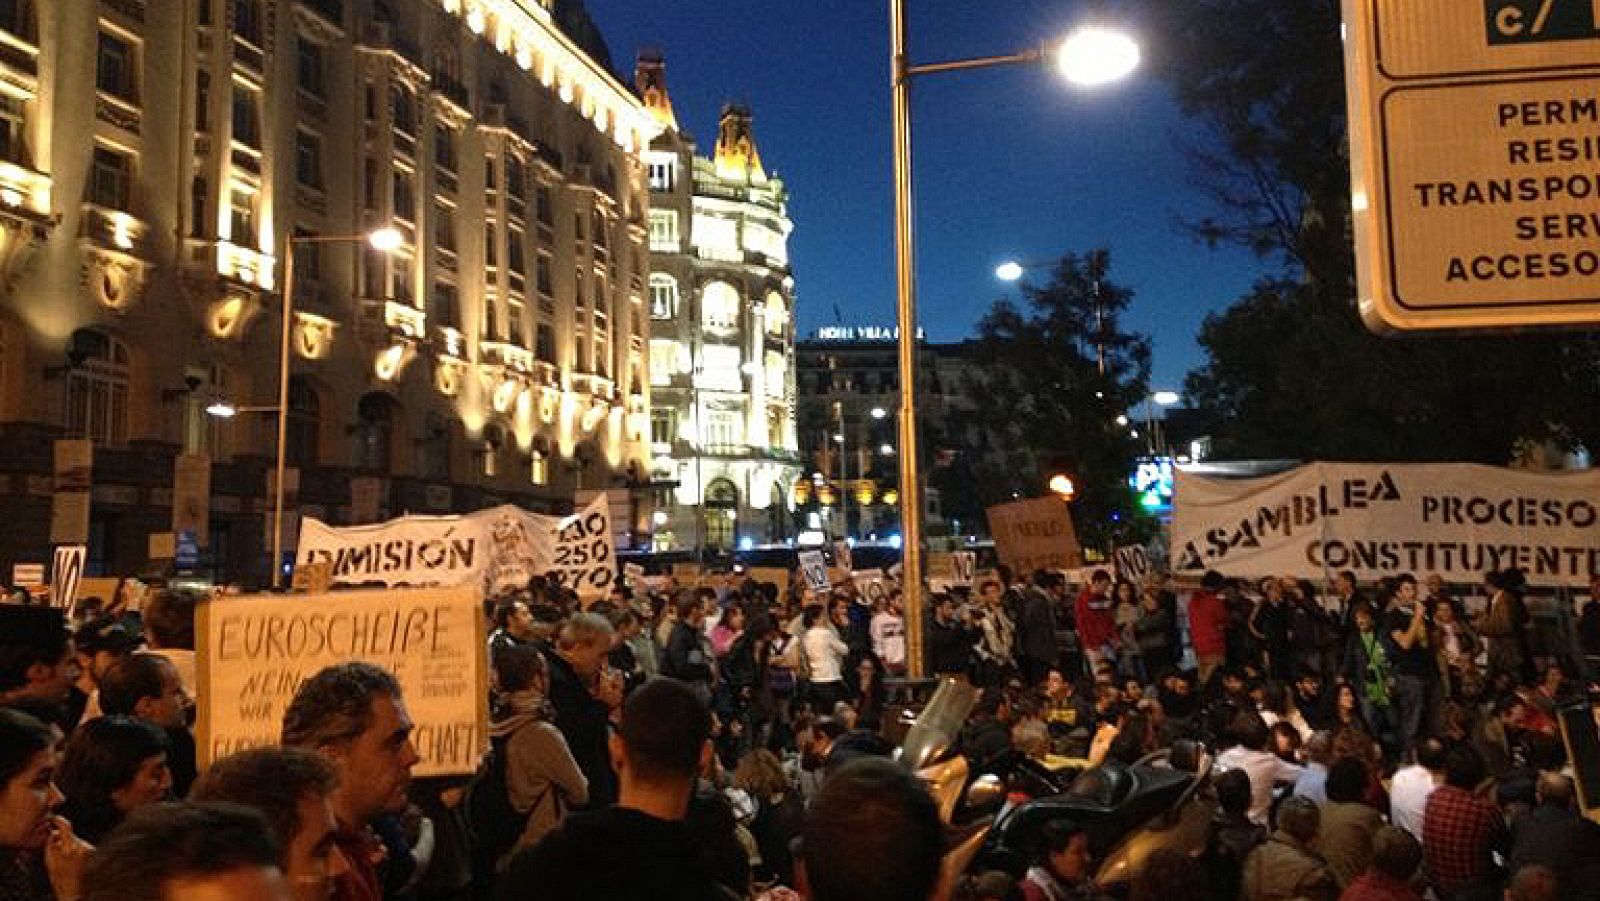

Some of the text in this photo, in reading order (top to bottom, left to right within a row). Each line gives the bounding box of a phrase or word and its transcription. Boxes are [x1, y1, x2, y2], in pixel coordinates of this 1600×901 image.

[1499, 98, 1597, 127] PERM
[1508, 136, 1600, 164] RESI
[1413, 174, 1600, 208] TRANSPO
[1446, 251, 1598, 282] ACCESO
[1176, 471, 1597, 569] ASAMBLEA PROCESO
[554, 540, 609, 565] 250
